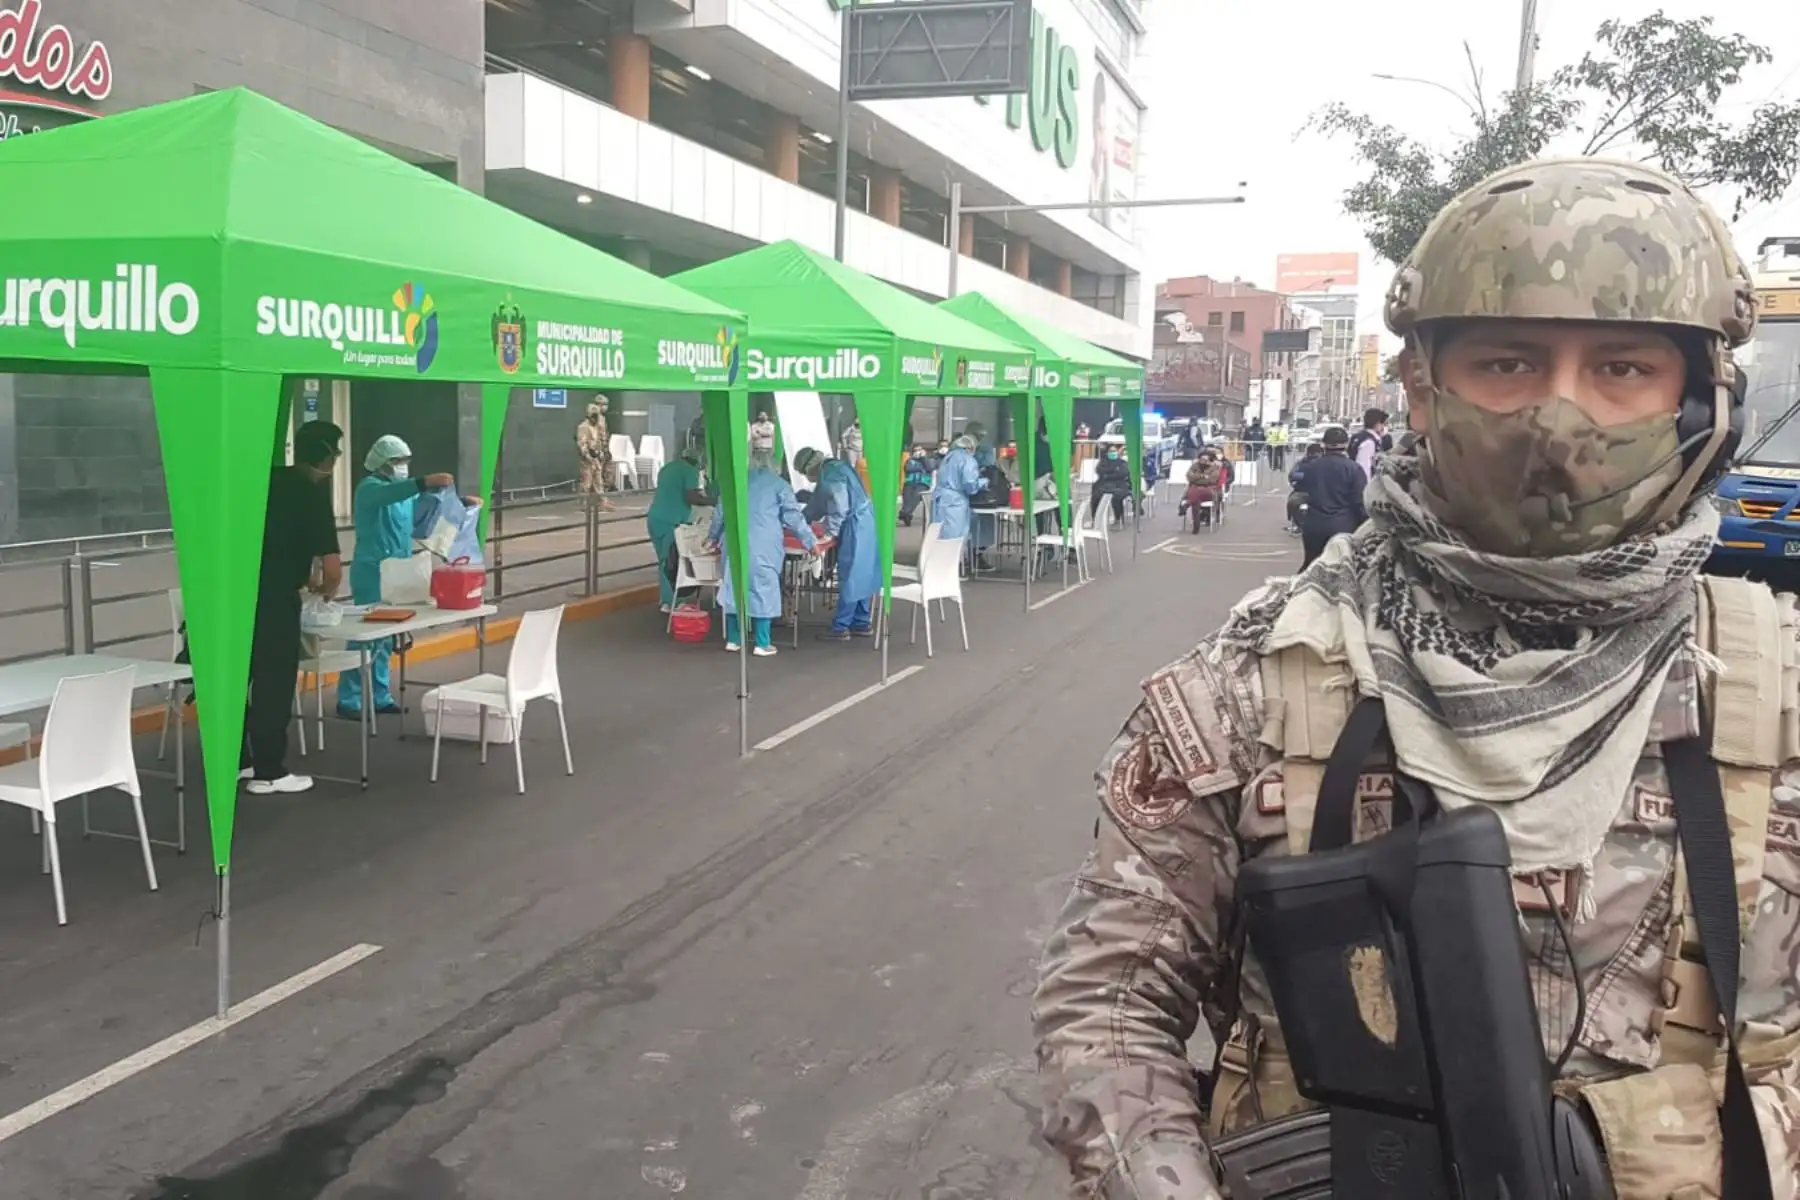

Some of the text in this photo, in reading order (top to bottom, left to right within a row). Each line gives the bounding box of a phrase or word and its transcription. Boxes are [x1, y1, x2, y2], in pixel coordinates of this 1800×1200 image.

[537, 320, 623, 346] MUNICIPALIDAD DE
[536, 341, 625, 379] SURQUILLO
[747, 347, 880, 388] Surquillo
